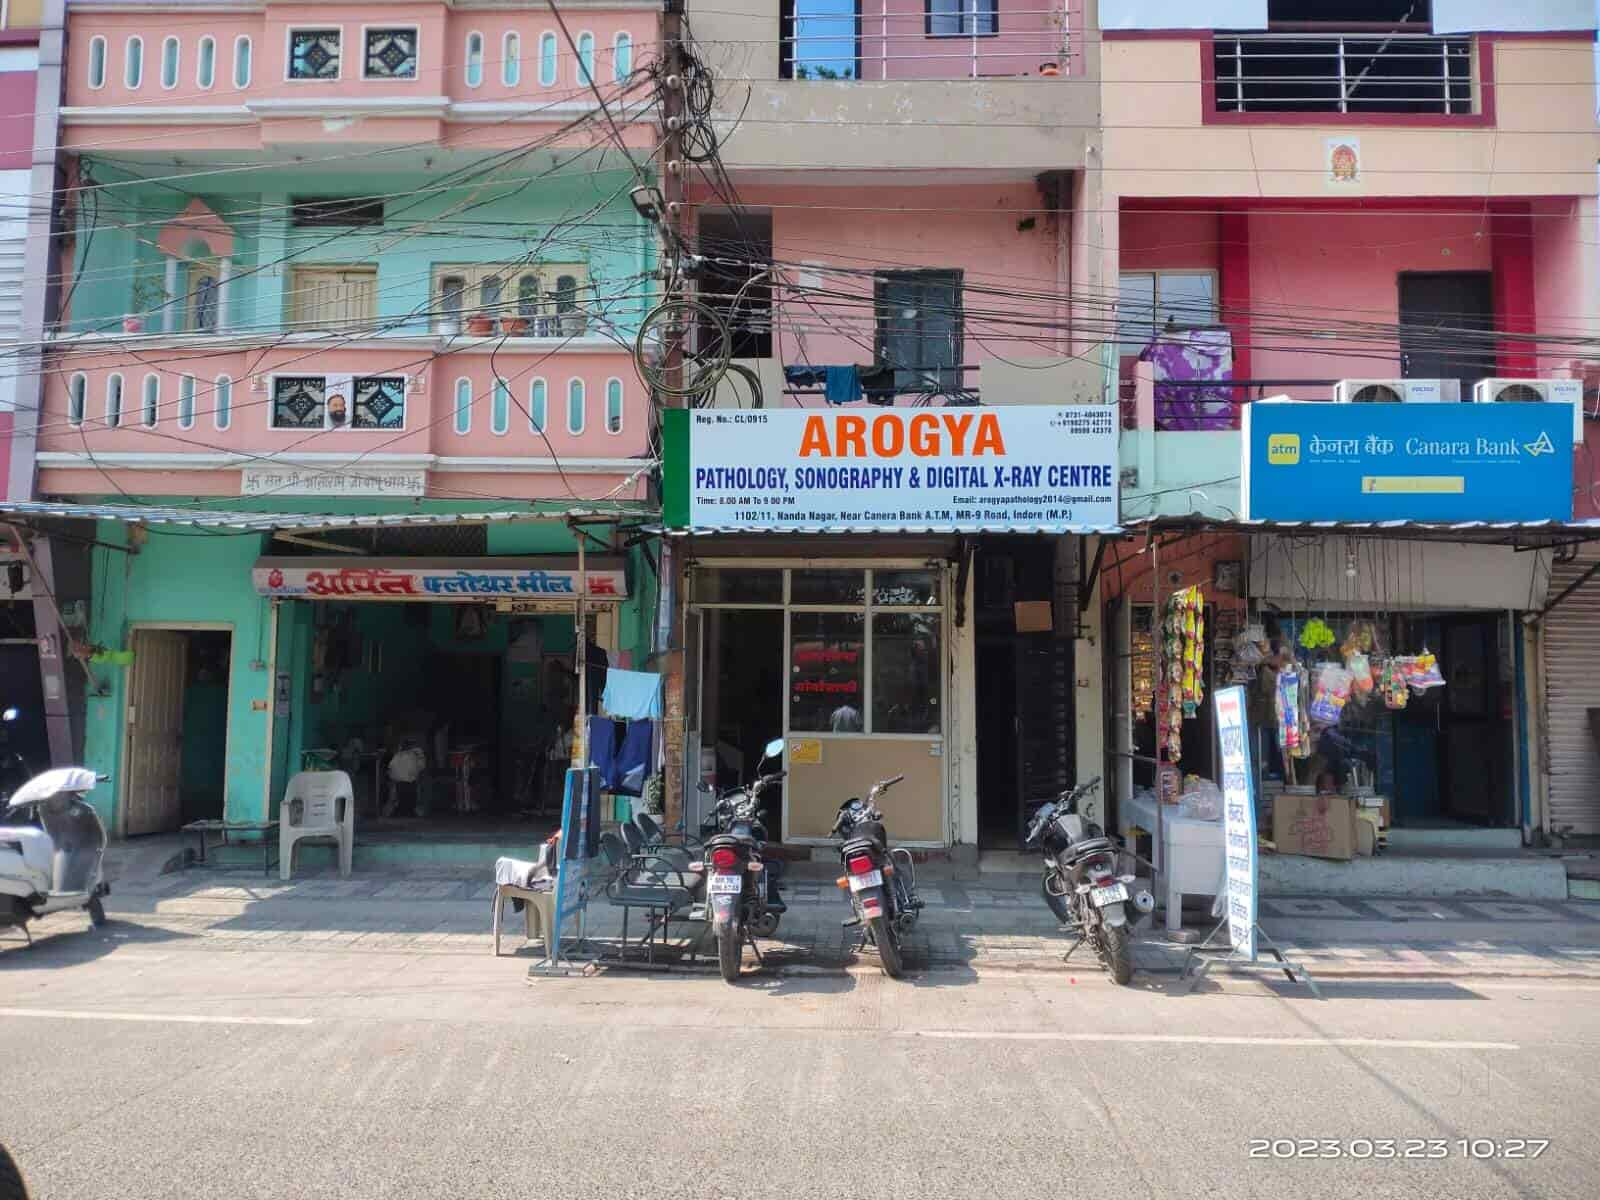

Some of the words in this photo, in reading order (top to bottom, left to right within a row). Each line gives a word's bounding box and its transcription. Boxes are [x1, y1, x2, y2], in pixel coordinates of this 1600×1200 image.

[696, 414, 714, 425] Reg.
[734, 414, 769, 424] CL/0915
[799, 414, 1006, 457] AROGYA
[1271, 444, 1297, 454] atm
[1308, 433, 1359, 455] केनरा
[1364, 432, 1394, 455] बैंक
[1405, 437, 1470, 456] Canara
[1476, 437, 1520, 455] Bank
[696, 467, 789, 492] PATHOLOGY,
[795, 466, 904, 490] SONOGRAPHY
[908, 466, 921, 489] &
[927, 465, 989, 488] DIGITAL
[993, 465, 1043, 488] X-RAY
[1048, 464, 1112, 488] CENTRE
[696, 496, 717, 505] Time:
[738, 496, 751, 505] AM
[753, 496, 762, 505] To
[782, 496, 795, 505] PM
[953, 495, 977, 504] Email:
[978, 494, 1112, 505] arogyapathology2014@gmail.com
[777, 510, 806, 521] Nanda
[840, 510, 862, 521] Near
[864, 510, 897, 521] Canera
[899, 510, 922, 521] Bank
[956, 509, 981, 521] MR-9
[984, 509, 1011, 521] Road,
[1013, 509, 1043, 521] Indore
[1046, 509, 1072, 521] (M.P.)
